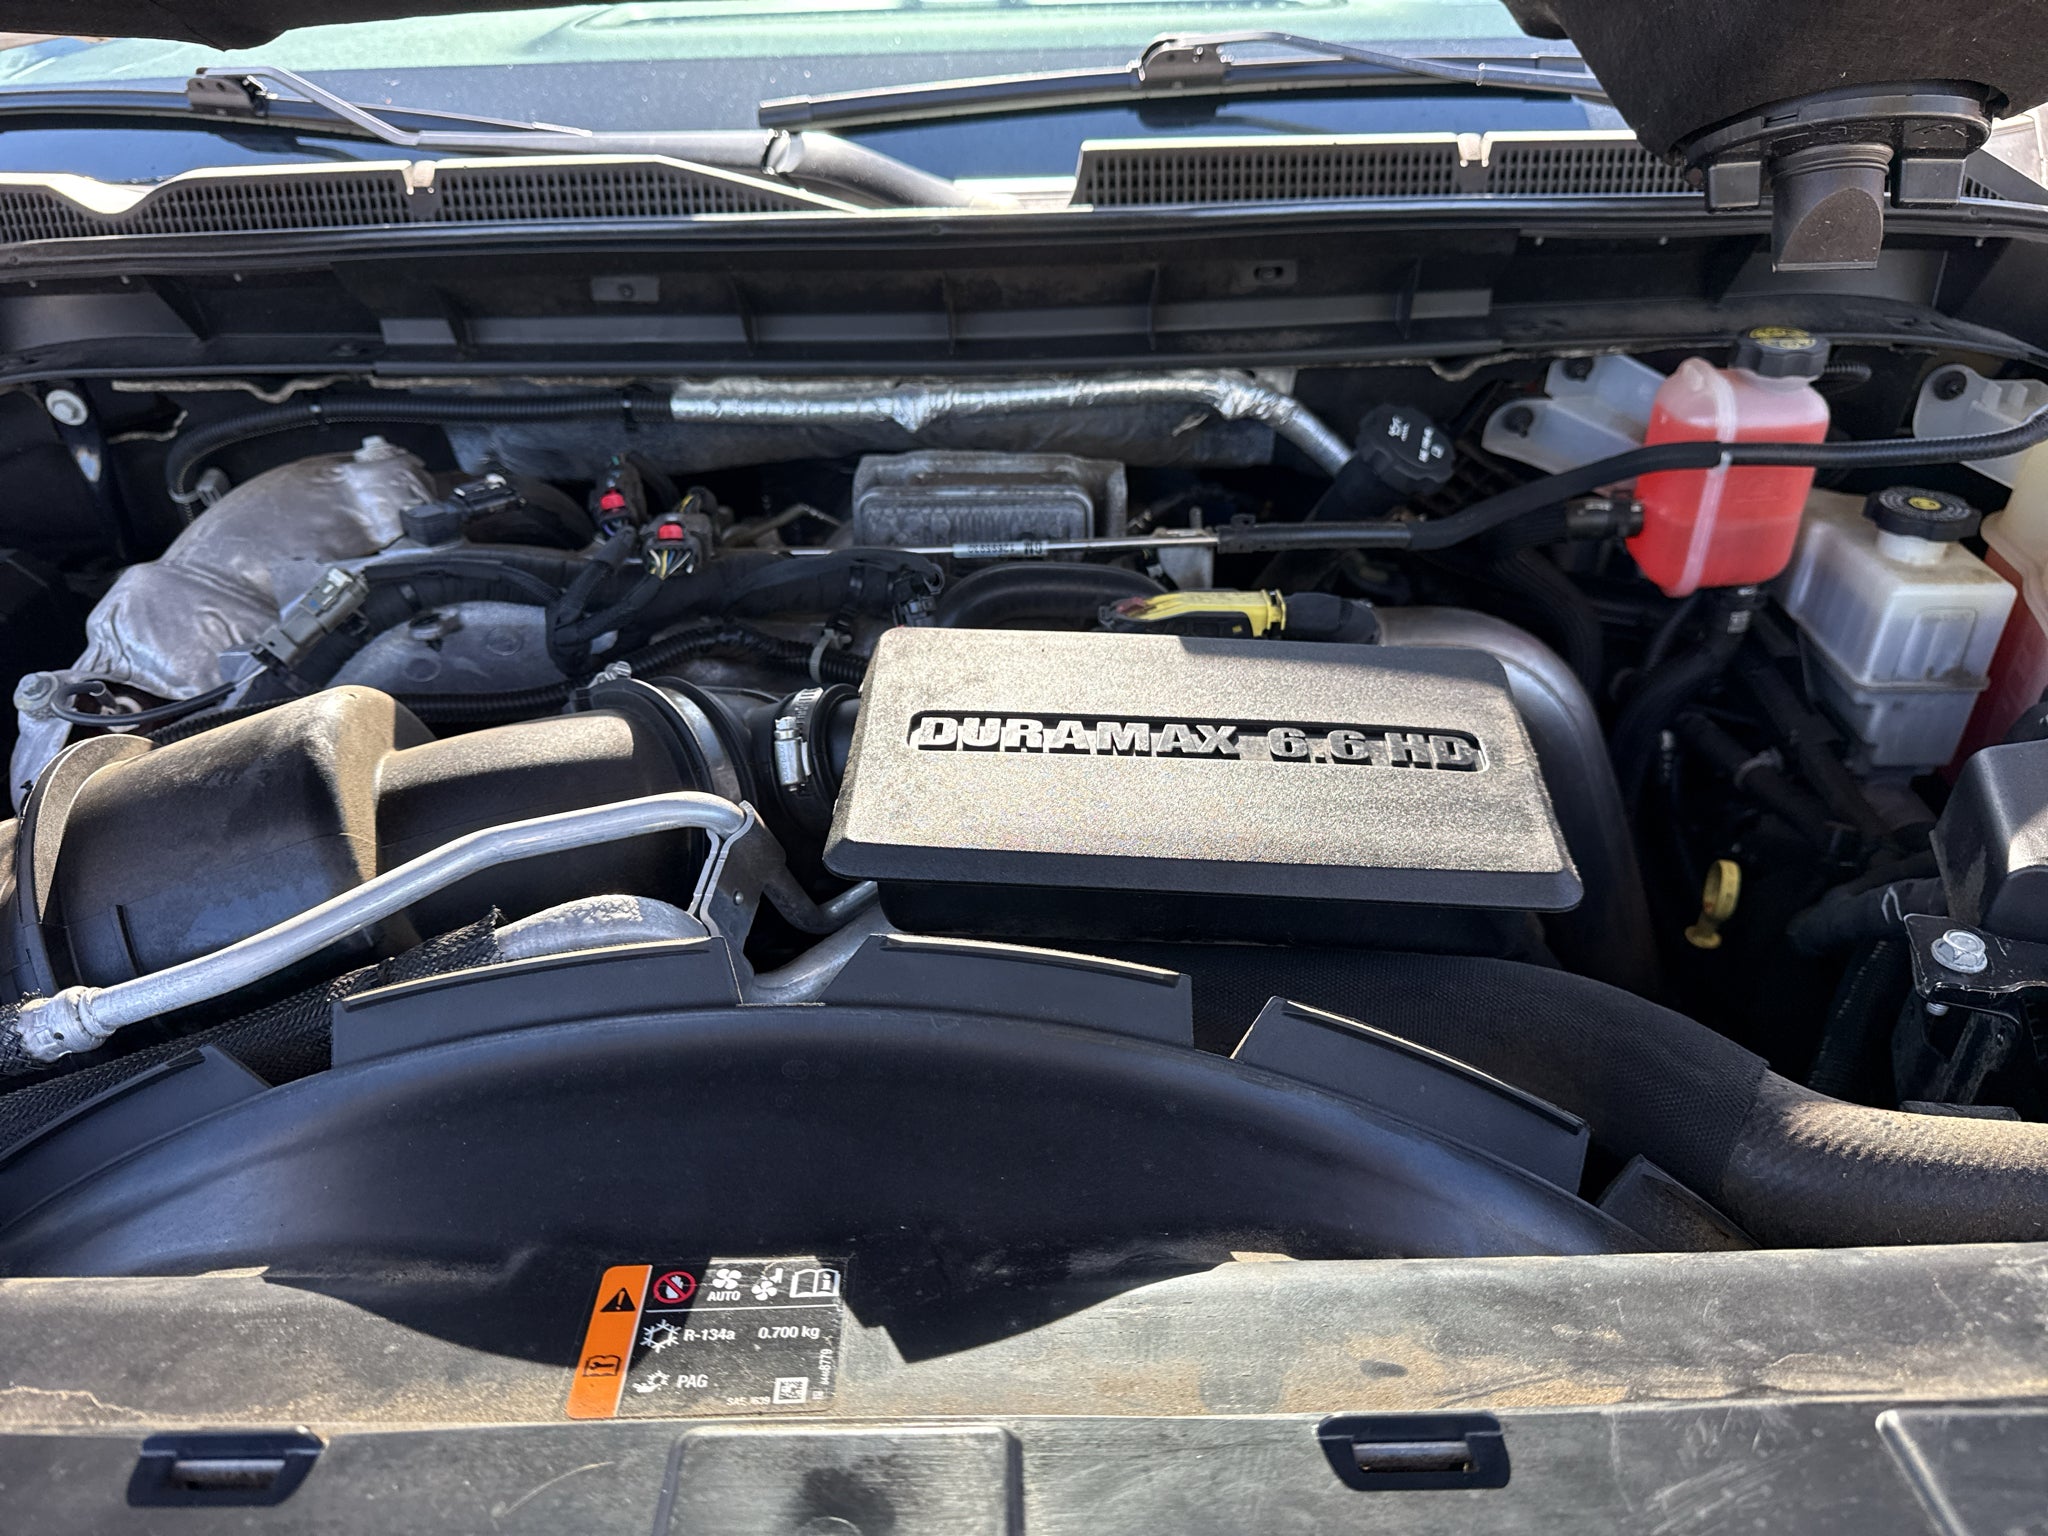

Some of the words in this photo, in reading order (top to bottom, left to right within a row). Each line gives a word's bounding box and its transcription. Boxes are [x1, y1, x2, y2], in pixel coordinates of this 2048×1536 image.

[1024, 541, 1043, 555] GM
[917, 715, 1240, 758] DURAMAX
[1268, 726, 1372, 763] 6.6
[1386, 730, 1477, 770] HD
[707, 1290, 741, 1302] AUTO
[683, 1328, 736, 1342] R-134a
[758, 1326, 799, 1340] 0.700
[801, 1325, 821, 1340] kg
[676, 1374, 709, 1389] PAG
